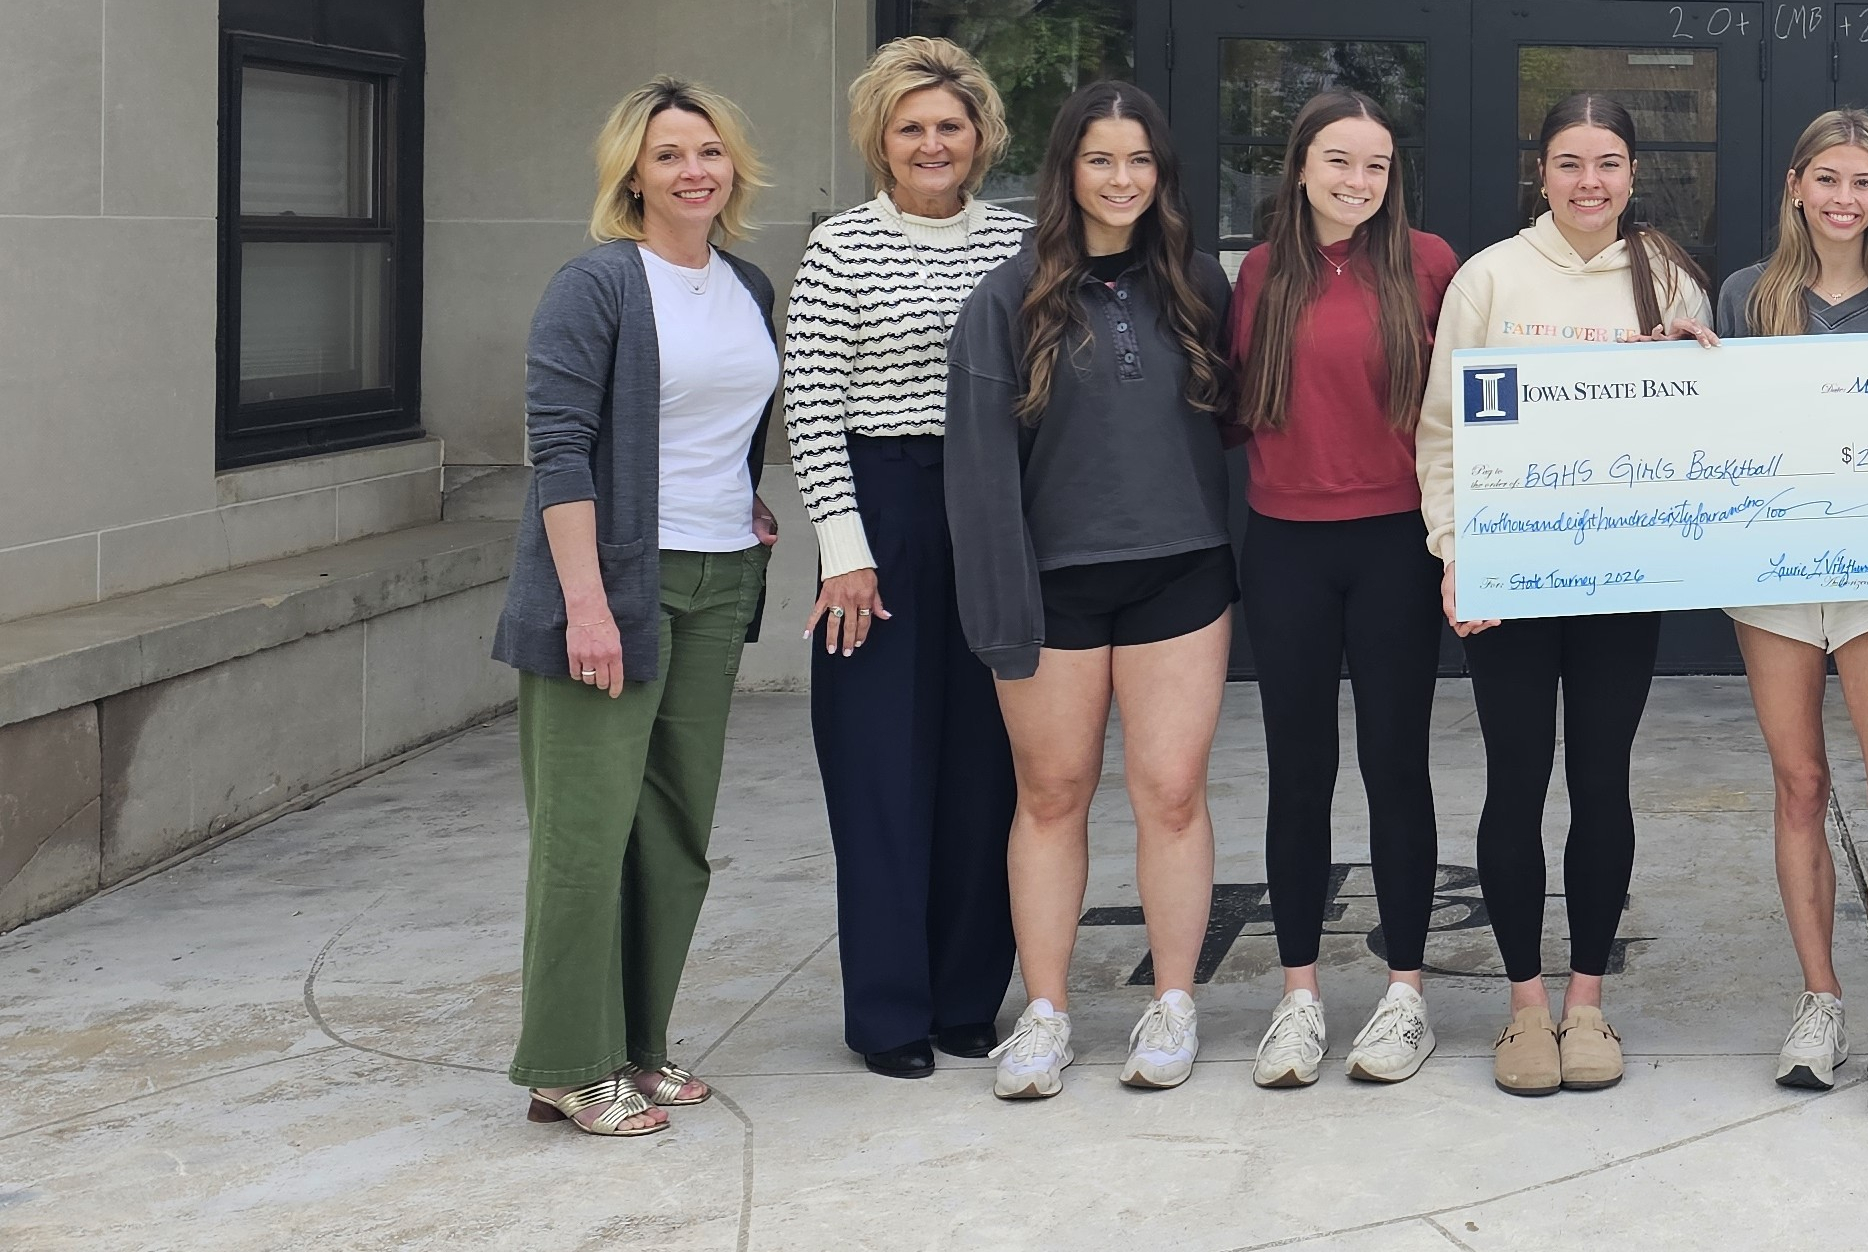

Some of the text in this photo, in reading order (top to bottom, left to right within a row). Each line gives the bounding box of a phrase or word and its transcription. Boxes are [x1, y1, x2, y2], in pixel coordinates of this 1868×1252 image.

[1774, 3, 1823, 41] CMB
[1503, 320, 1557, 336] FAITH
[1561, 325, 1609, 343] OVER
[1521, 379, 1700, 403] IOWA STATE BANK
[1470, 478, 1484, 489] the
[1484, 478, 1508, 489] order
[1524, 459, 1594, 490] BGHS
[1608, 453, 1675, 489] Girls
[1471, 464, 1504, 480] Pay to
[1545, 568, 1597, 596] Tourney
[1603, 569, 1646, 585] 2026
